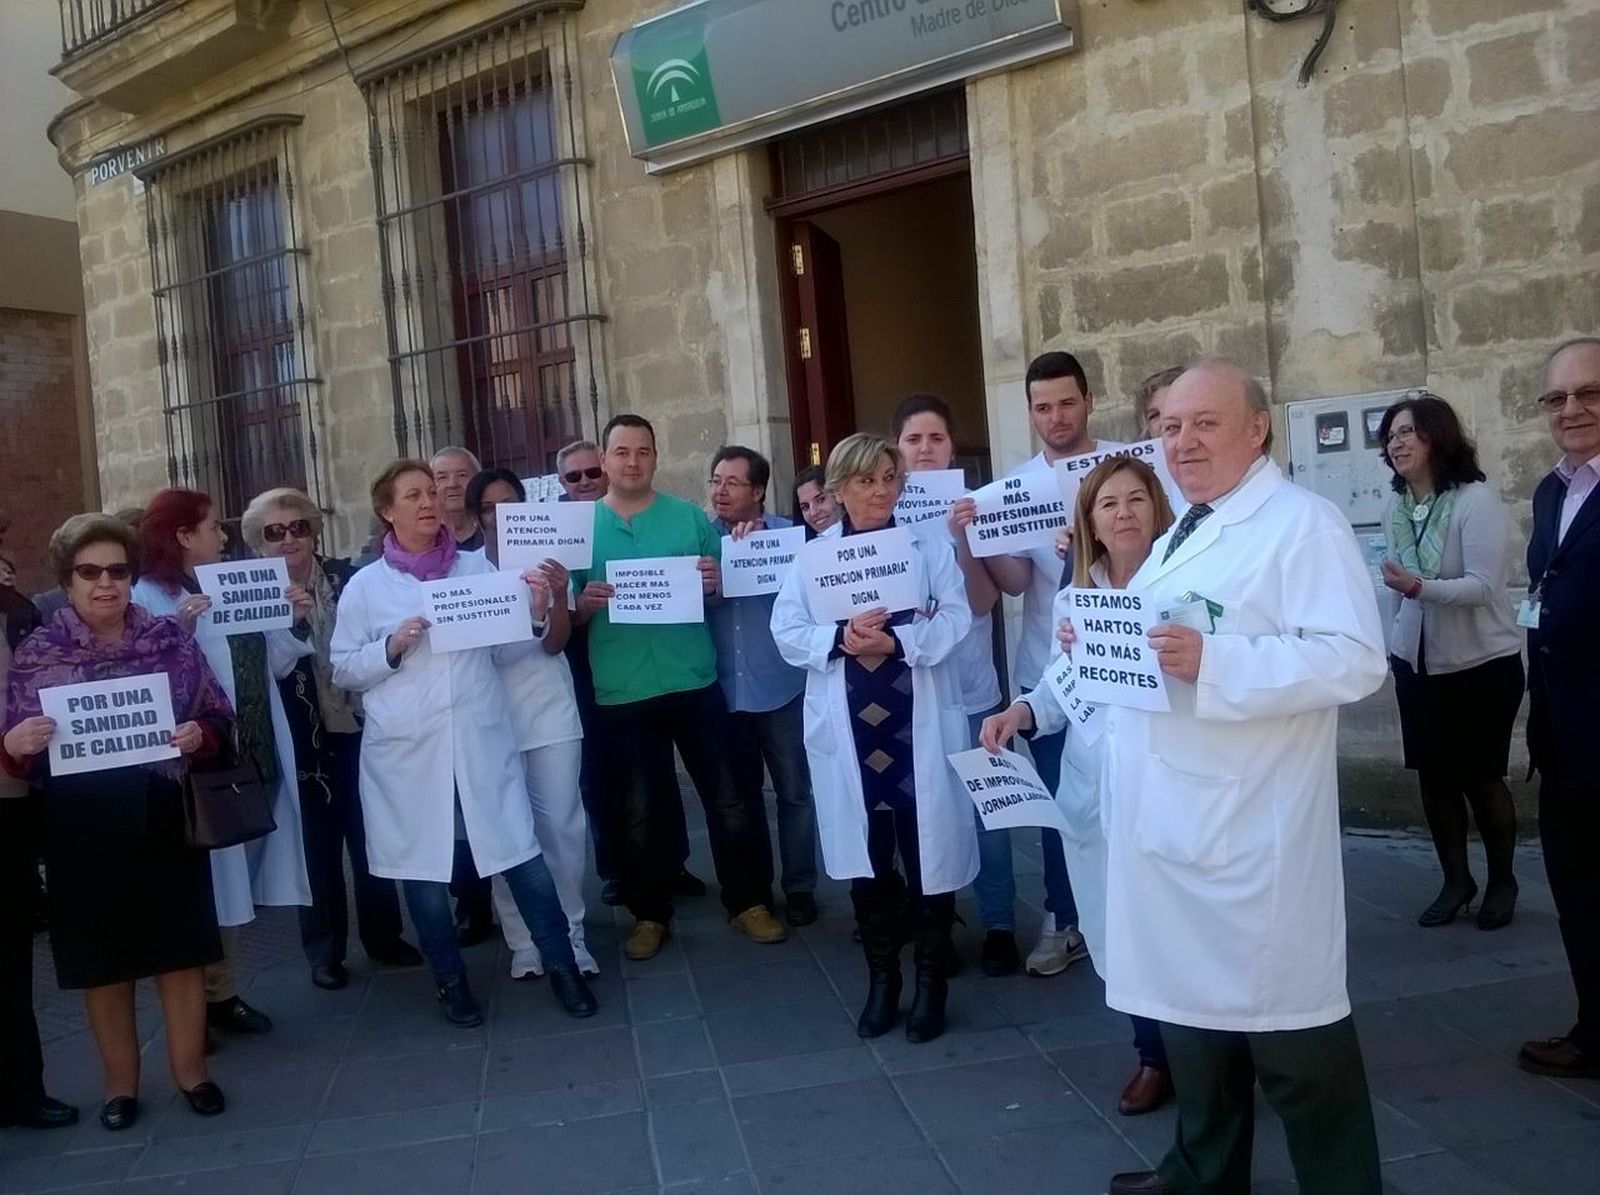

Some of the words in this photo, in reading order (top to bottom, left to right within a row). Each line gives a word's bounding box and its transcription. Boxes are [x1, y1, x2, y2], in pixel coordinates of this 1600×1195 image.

[910, 8, 962, 38] Madre
[965, 0, 986, 19] de
[91, 137, 165, 186] PORVENIR
[1005, 478, 1022, 490] NO
[1003, 489, 1030, 506] MÁS
[529, 514, 551, 522] UNA
[506, 526, 558, 535] ATENCION
[978, 527, 1000, 541] SIN
[1002, 516, 1067, 537] SUSTITUIR
[507, 538, 555, 546] PRIMARIA
[557, 537, 586, 546] DIGNA
[750, 541, 765, 550] POR
[766, 538, 781, 549] UNA
[769, 552, 798, 566] PRIMAR
[837, 548, 856, 562] POR
[858, 544, 878, 558] UNA
[217, 569, 247, 586] POR
[249, 568, 278, 583] UNA
[615, 569, 665, 578] IMPOSIBLE
[757, 573, 777, 585] DIGNA
[815, 569, 863, 589] "ATENCION
[864, 560, 909, 581] PRIMARIA"
[615, 581, 648, 589] HACER
[649, 580, 670, 588] MAS
[222, 586, 281, 605] SANIDAD
[432, 592, 447, 600] NO
[449, 588, 472, 597] MAS
[434, 594, 518, 612] PROFESIONALES
[616, 593, 636, 601] CON
[638, 591, 672, 600] MENOS
[851, 589, 880, 606] DIGNA
[1074, 594, 1142, 611] ESTAMOS
[213, 610, 231, 625] DE
[233, 603, 290, 622] CALIDAD
[436, 615, 454, 625] SIN
[456, 607, 511, 622] SUSTITUIR
[644, 603, 664, 611] VEZ
[1083, 618, 1143, 636] HARTOS
[1085, 642, 1106, 657] NO
[1110, 642, 1142, 661] MÁS
[1055, 665, 1073, 685] BAS
[1079, 665, 1158, 689] RECORTES
[1062, 679, 1077, 698] IMP
[66, 694, 109, 713] POR
[111, 688, 154, 708] UNA
[70, 709, 158, 736] SANIDAD
[1078, 705, 1098, 724] LAB
[59, 742, 87, 760] DE
[90, 729, 173, 756] CALIDAD
[966, 778, 984, 792] DE
[980, 793, 1025, 816] JORNADA
